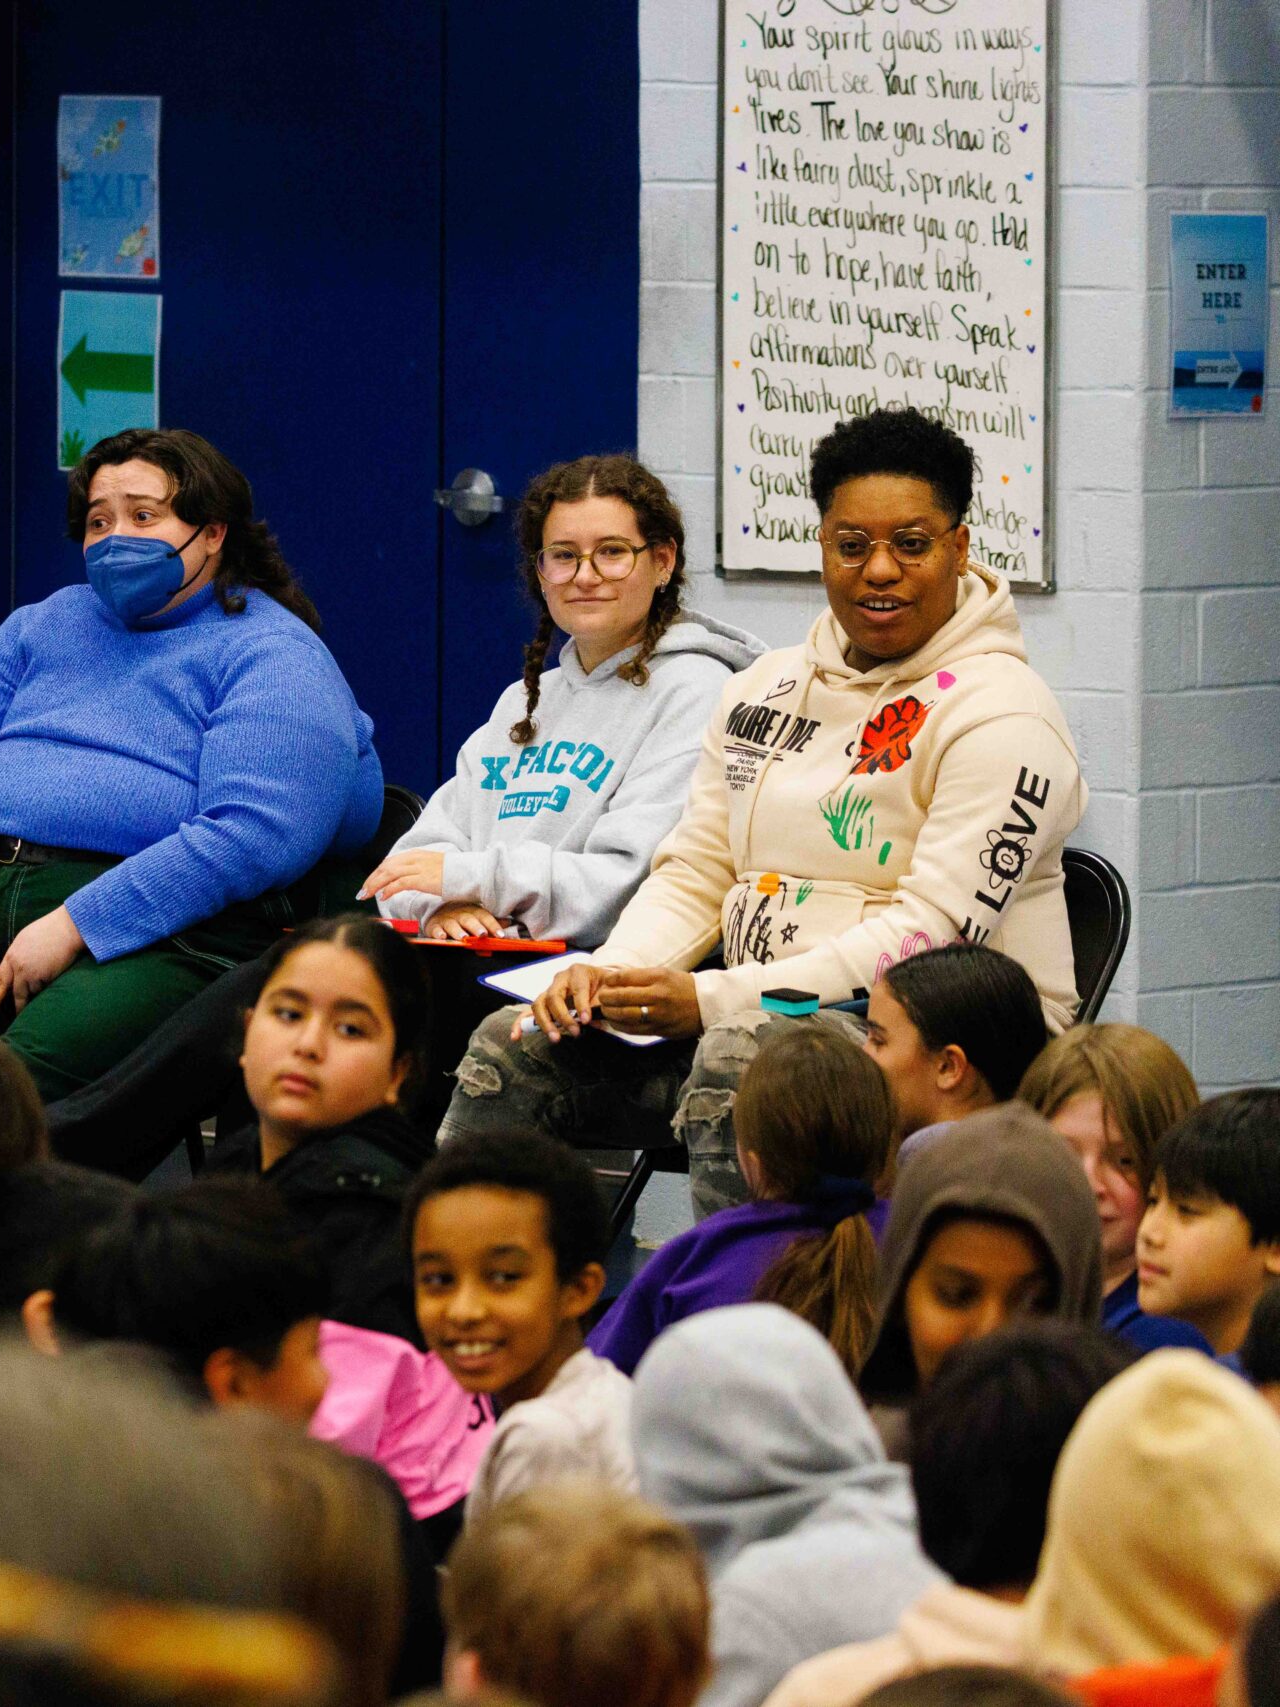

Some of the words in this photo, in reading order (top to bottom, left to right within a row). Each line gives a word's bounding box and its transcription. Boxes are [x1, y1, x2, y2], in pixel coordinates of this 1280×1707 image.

[746, 11, 795, 49] Your
[805, 19, 871, 60] spirit
[883, 19, 942, 72] glows
[955, 28, 977, 50] in
[981, 27, 1032, 72] ways
[746, 66, 782, 107] you
[876, 62, 917, 96] Your
[926, 69, 984, 101] shine
[810, 101, 849, 141] The
[855, 109, 890, 142] love
[894, 122, 926, 156] you
[932, 119, 984, 151] show
[993, 127, 1012, 155] is
[70, 172, 149, 208] EXIT
[794, 148, 841, 203] fairy
[1006, 182, 1023, 204] a
[808, 200, 906, 249] everywhere
[913, 213, 948, 253] you
[992, 212, 1029, 252] Hold
[754, 240, 780, 273] on
[788, 238, 811, 275] to
[878, 250, 929, 292] have
[1196, 263, 1247, 280] ENTER
[753, 276, 822, 323] believe
[829, 300, 851, 326] in
[951, 303, 1022, 355] Speak
[1201, 292, 1242, 309] HERE
[750, 323, 877, 370] affirmations
[751, 367, 844, 423] Positivity
[982, 401, 1026, 442] will
[480, 756, 511, 790] X
[726, 764, 739, 773] NEW
[974, 765, 1051, 914] LOVE
